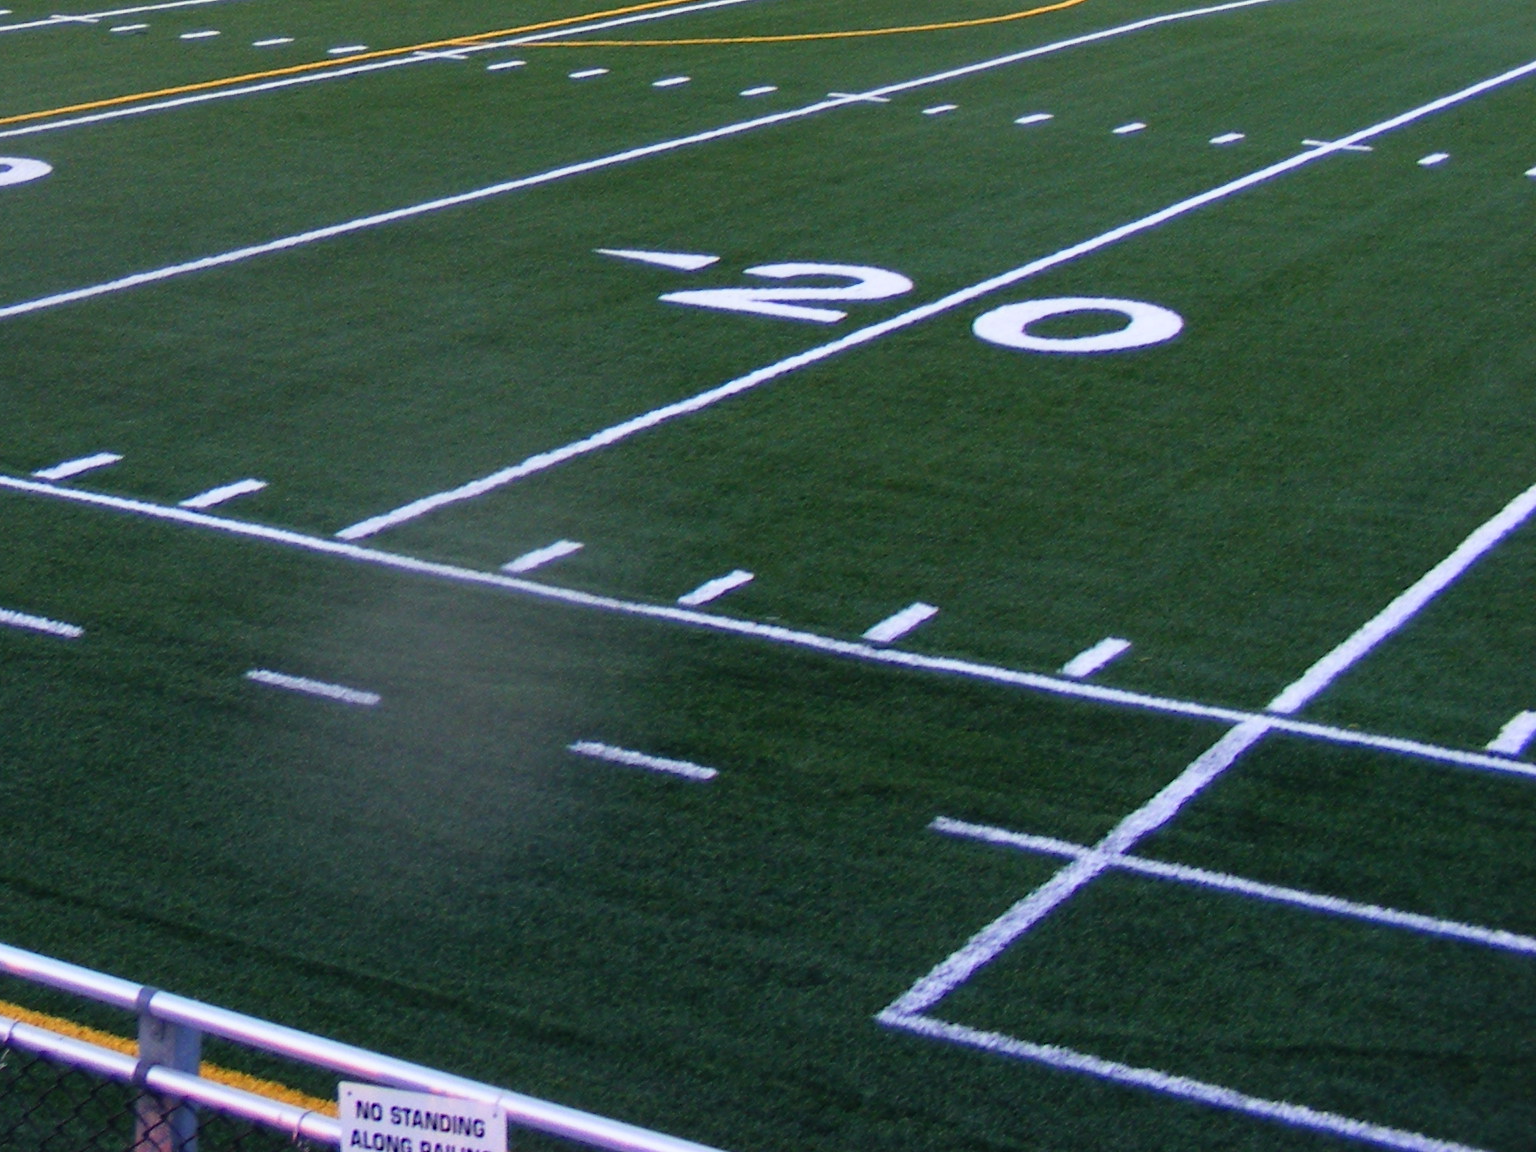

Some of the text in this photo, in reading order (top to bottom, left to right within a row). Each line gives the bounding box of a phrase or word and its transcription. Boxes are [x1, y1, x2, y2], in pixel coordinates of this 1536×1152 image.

[356, 1100, 486, 1138] NO STANDING
[350, 1129, 412, 1152] ALONG
